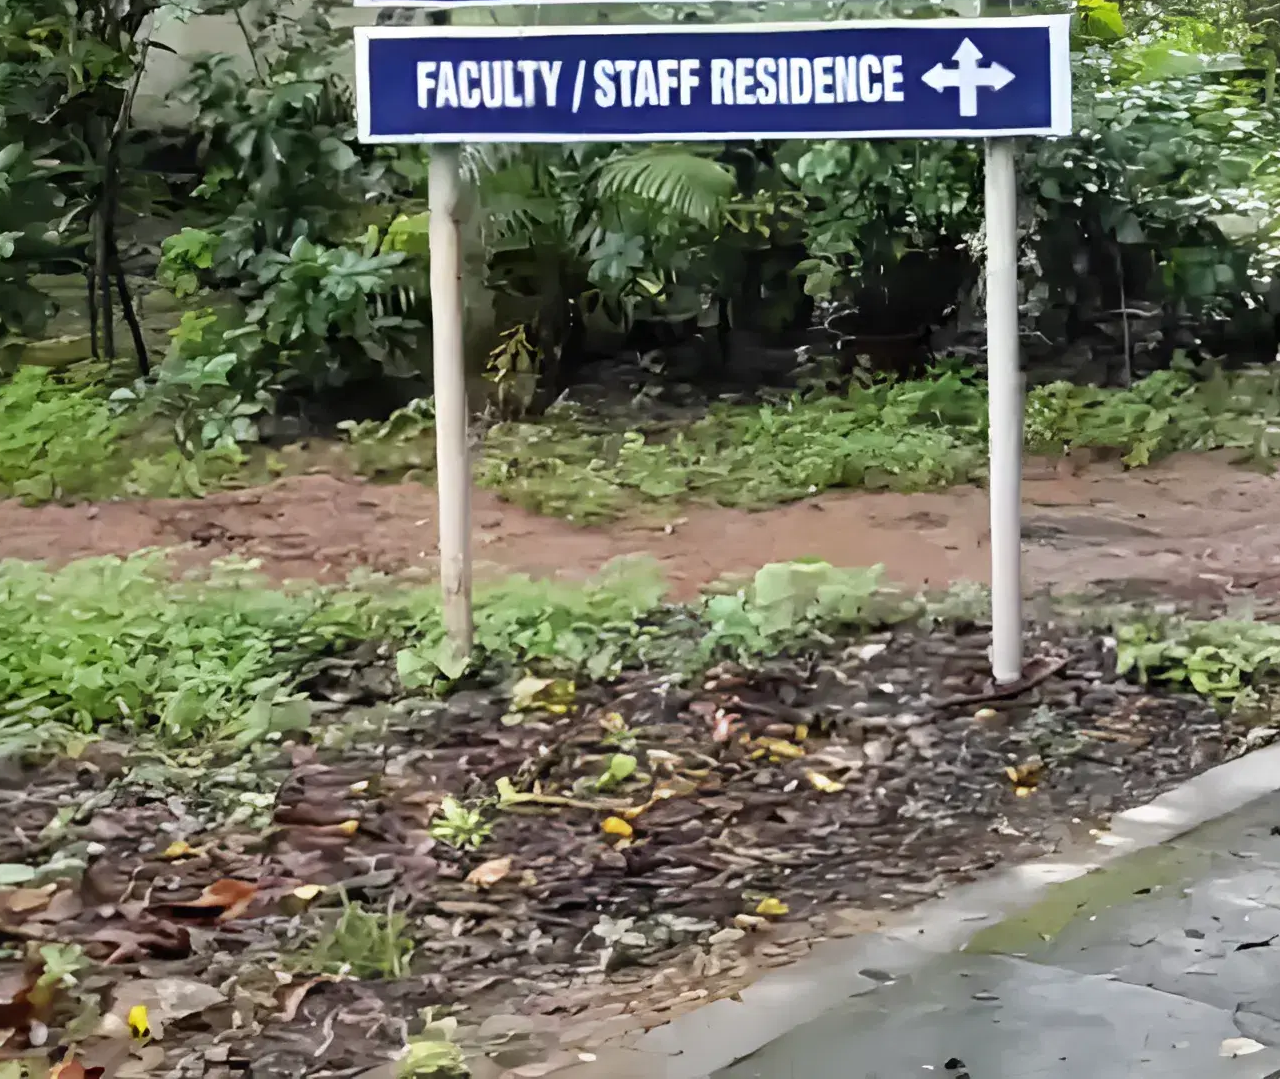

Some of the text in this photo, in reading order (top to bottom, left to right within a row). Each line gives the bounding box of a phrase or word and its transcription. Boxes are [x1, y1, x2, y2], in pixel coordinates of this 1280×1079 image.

[416, 53, 905, 114] FACULTY / STAFF RESIDENCE
